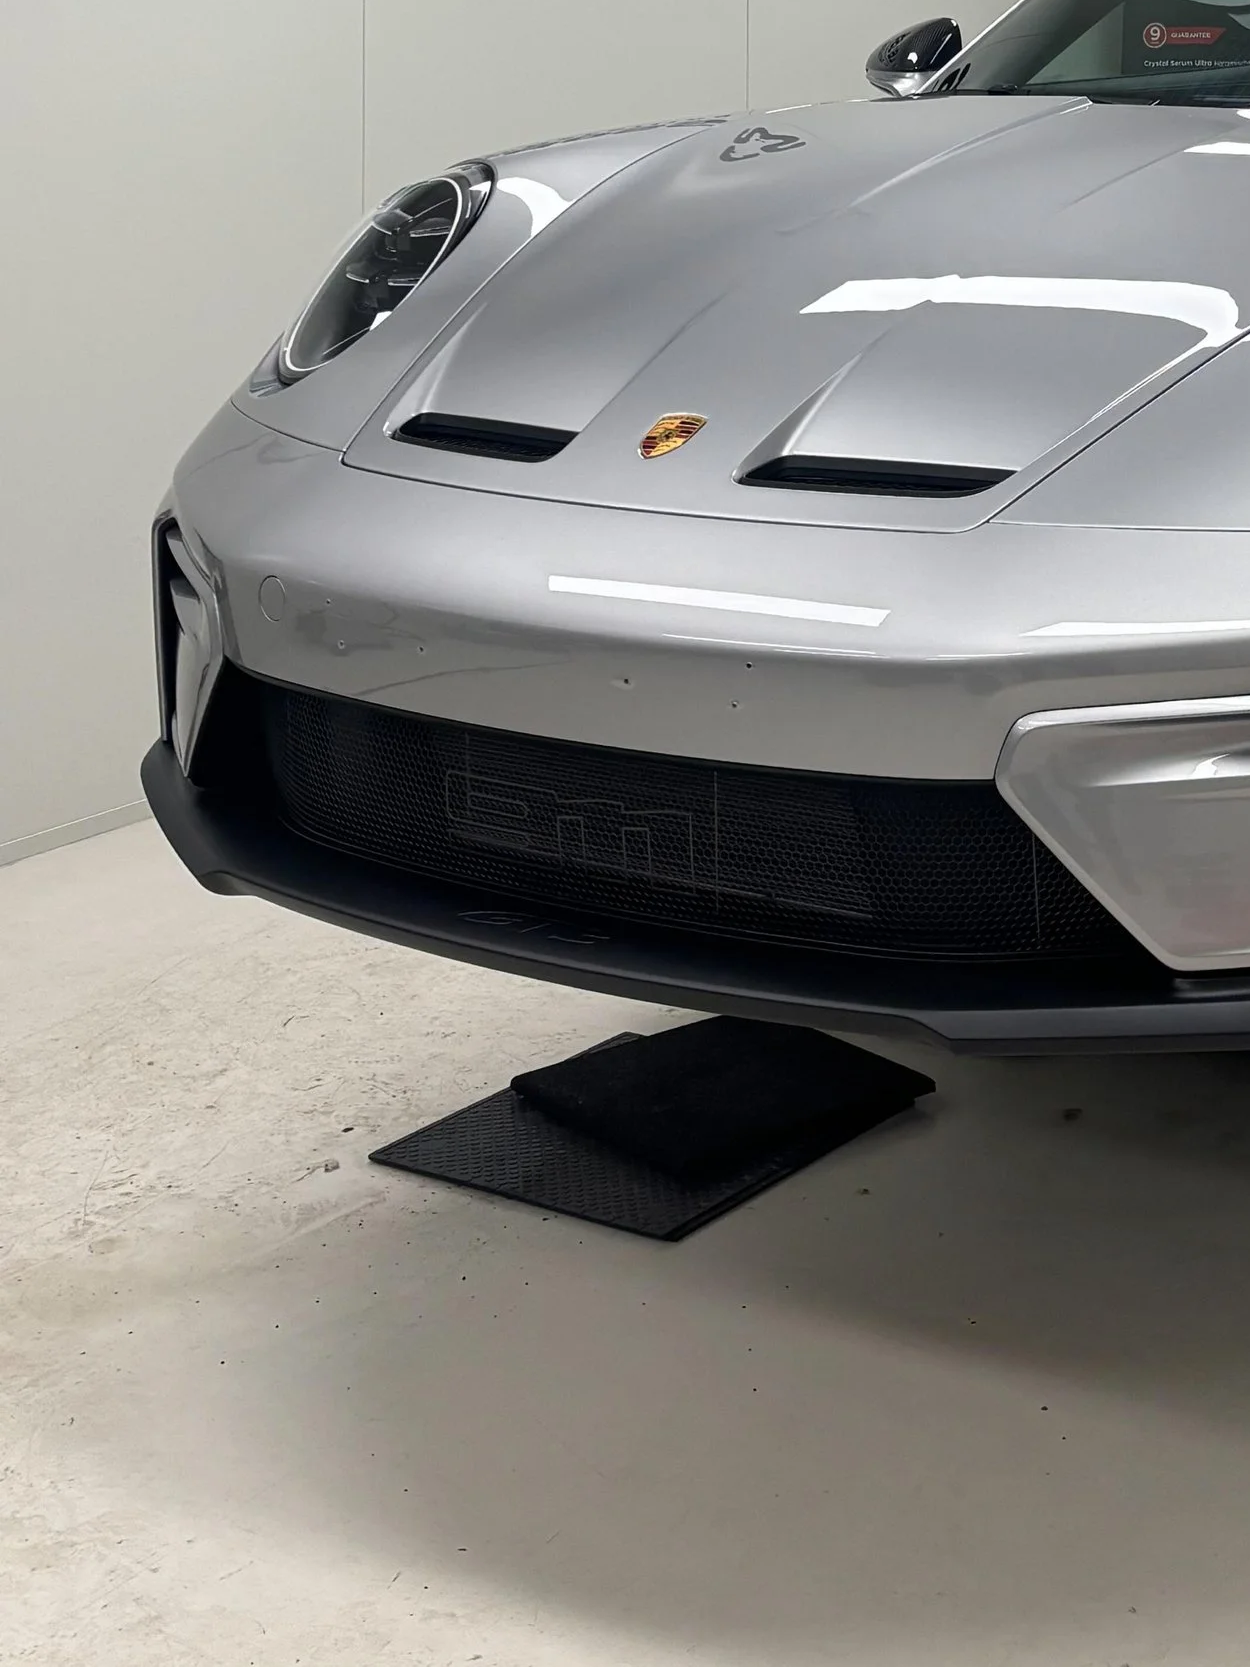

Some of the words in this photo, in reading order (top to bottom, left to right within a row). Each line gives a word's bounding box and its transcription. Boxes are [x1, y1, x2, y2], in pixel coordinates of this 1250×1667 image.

[1149, 25, 1161, 41] 9
[1143, 59, 1169, 68] Crystal
[1194, 59, 1213, 67] Ultra
